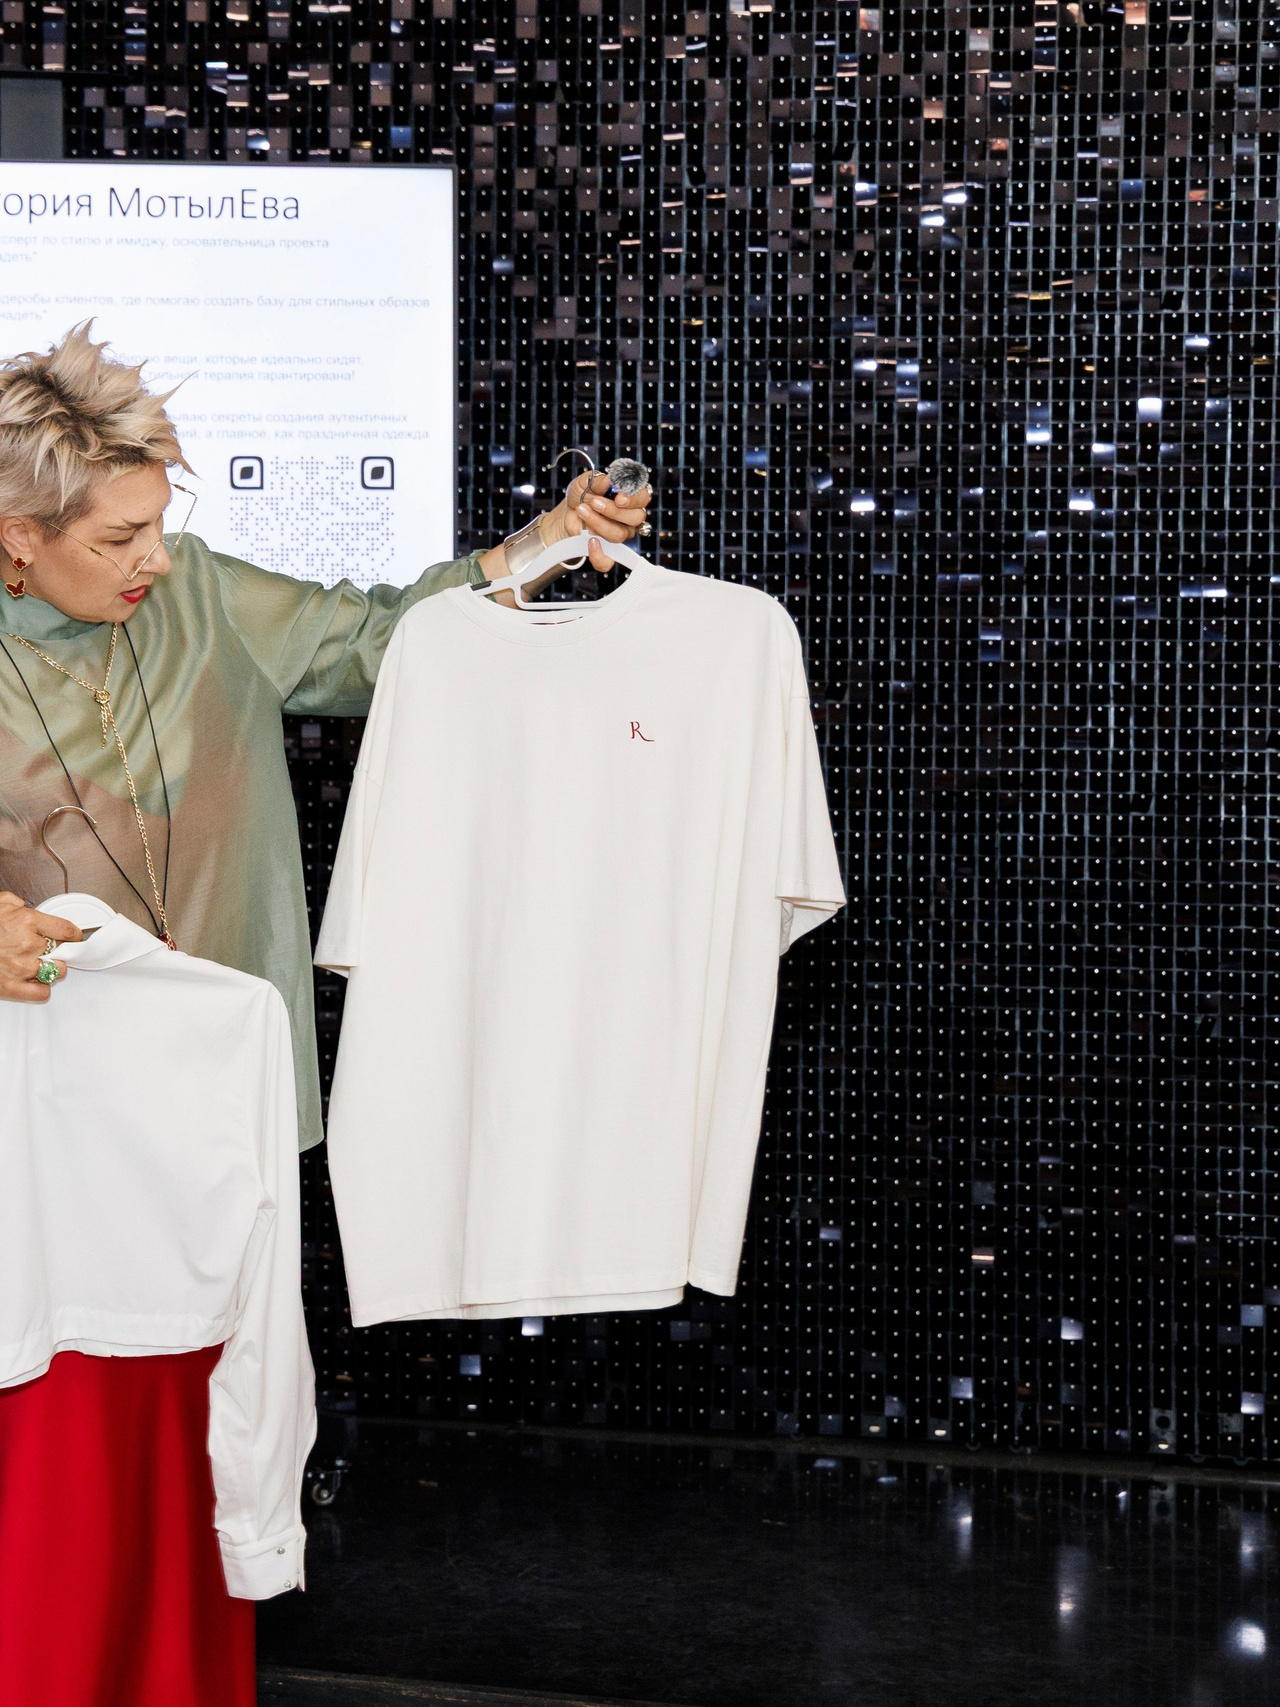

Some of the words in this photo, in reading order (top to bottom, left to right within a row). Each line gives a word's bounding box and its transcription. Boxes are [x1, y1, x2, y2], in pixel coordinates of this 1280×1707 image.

[108, 186, 301, 220] МотылЕва
[42, 236, 58, 246] по
[61, 237, 101, 247] стилю
[105, 237, 113, 247] и
[172, 238, 275, 250] основательница
[279, 239, 329, 250] проекта
[121, 296, 141, 307] где
[145, 296, 200, 306] помогаю
[204, 297, 253, 308] создать
[256, 295, 284, 309] базу
[288, 298, 312, 308] для
[315, 298, 375, 308] стильных
[378, 296, 430, 309] образов
[205, 354, 258, 367] которые
[261, 355, 322, 367] идеально
[204, 372, 254, 383] терапия
[258, 371, 355, 383] гарантирована!
[211, 412, 262, 424] секреты
[265, 412, 324, 424] создания
[327, 413, 408, 425] аутентичных
[205, 430, 212, 439] а
[274, 430, 294, 439] как
[298, 429, 378, 441] праздничная
[382, 430, 429, 441] одежда
[630, 721, 654, 742] R
